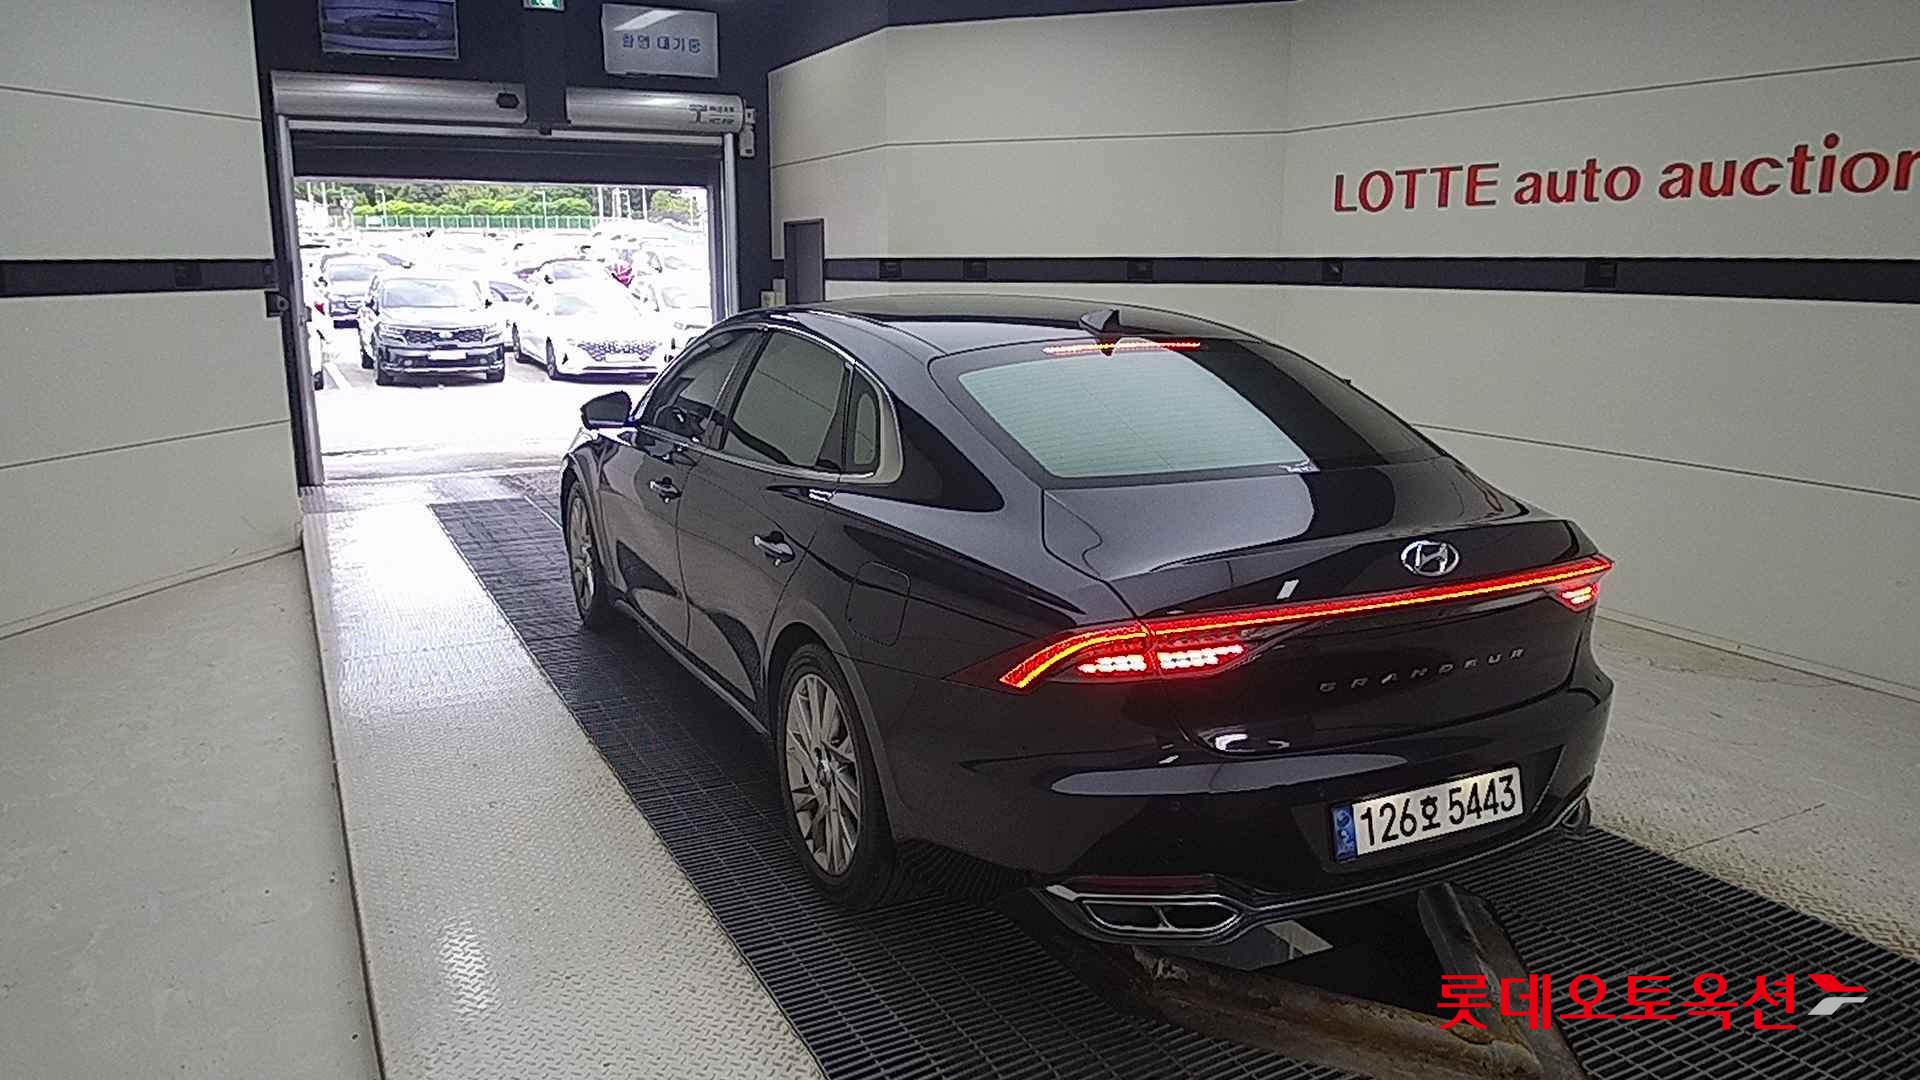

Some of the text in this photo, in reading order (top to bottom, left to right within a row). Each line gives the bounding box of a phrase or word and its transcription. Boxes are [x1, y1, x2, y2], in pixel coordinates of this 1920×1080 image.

[1333, 162, 1500, 212] LOTTE
[1513, 158, 1641, 205] auto
[1319, 648, 1525, 692] GRANDEUR
[1360, 774, 1516, 846] 126호 5443
